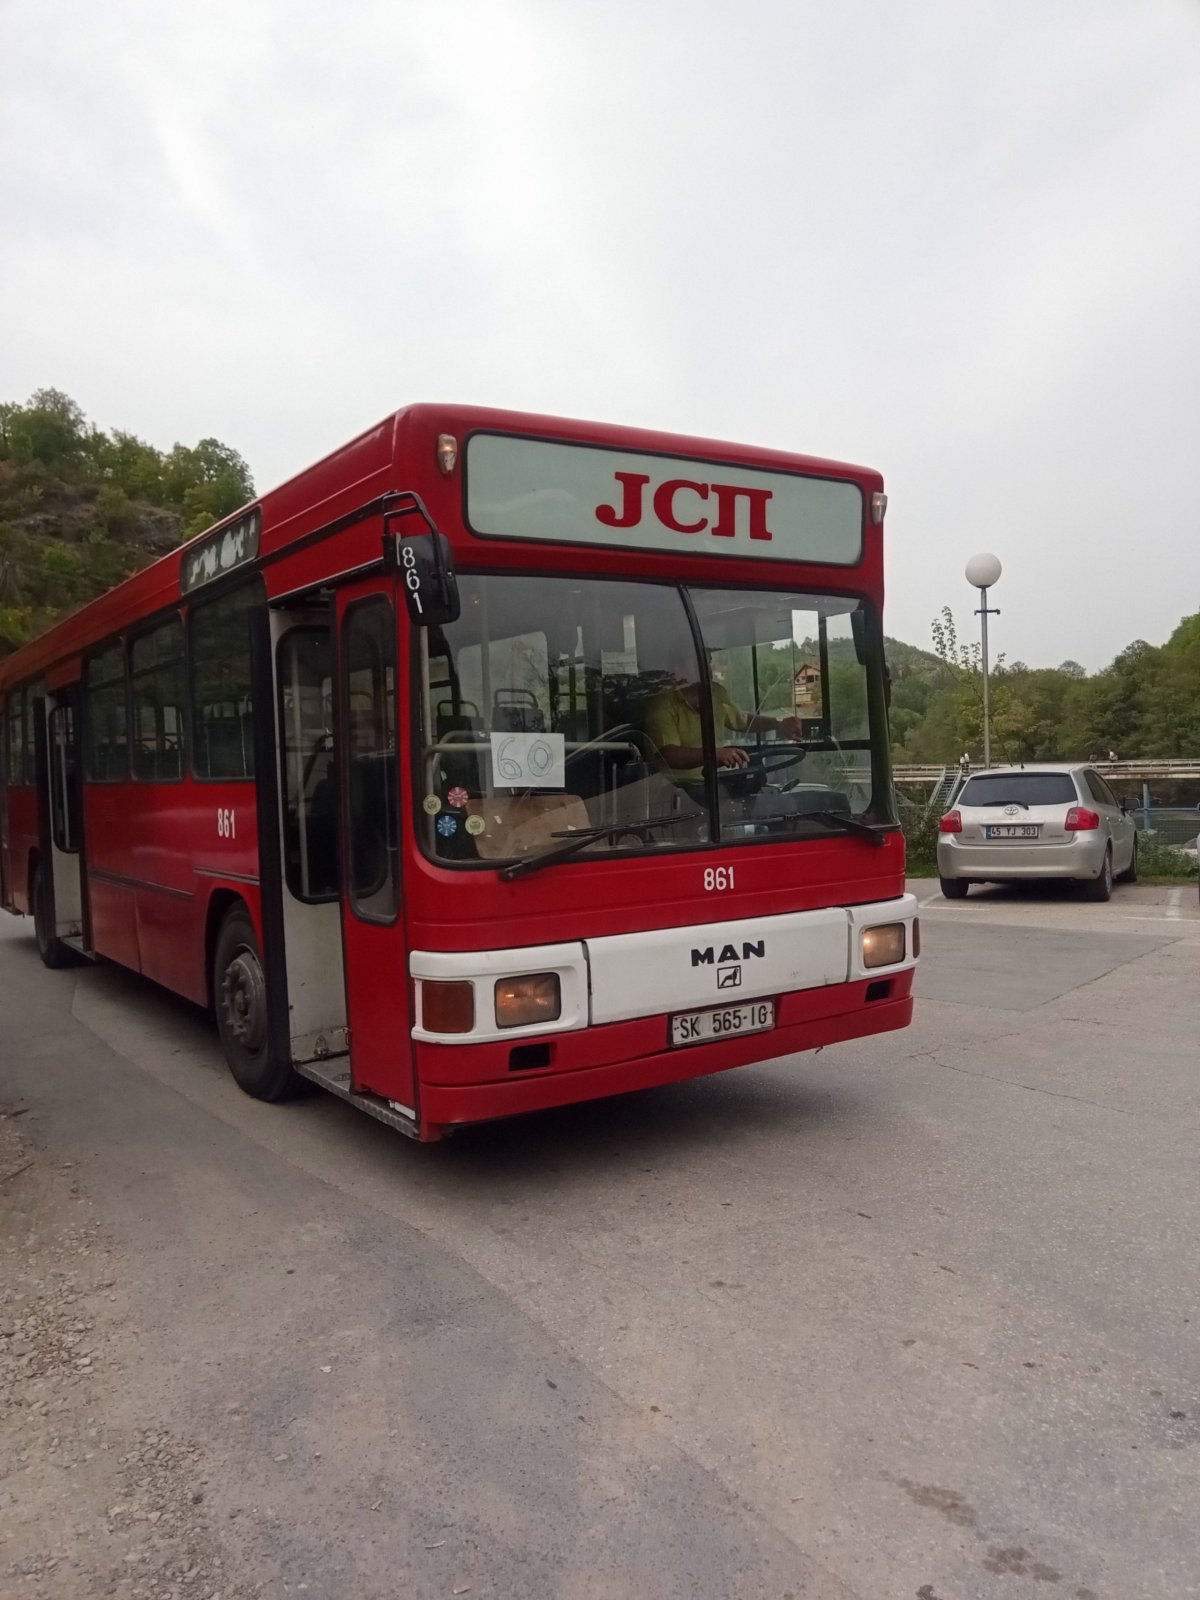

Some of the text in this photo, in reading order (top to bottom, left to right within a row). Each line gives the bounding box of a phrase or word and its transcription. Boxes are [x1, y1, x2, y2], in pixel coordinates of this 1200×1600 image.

[402, 546, 423, 614] 861
[496, 736, 554, 780] 60
[217, 807, 236, 840] 861
[991, 826, 1001, 836] 45
[1021, 826, 1036, 836] 303
[703, 866, 735, 891] 861
[690, 940, 765, 967] MAN
[679, 1015, 701, 1040] SK
